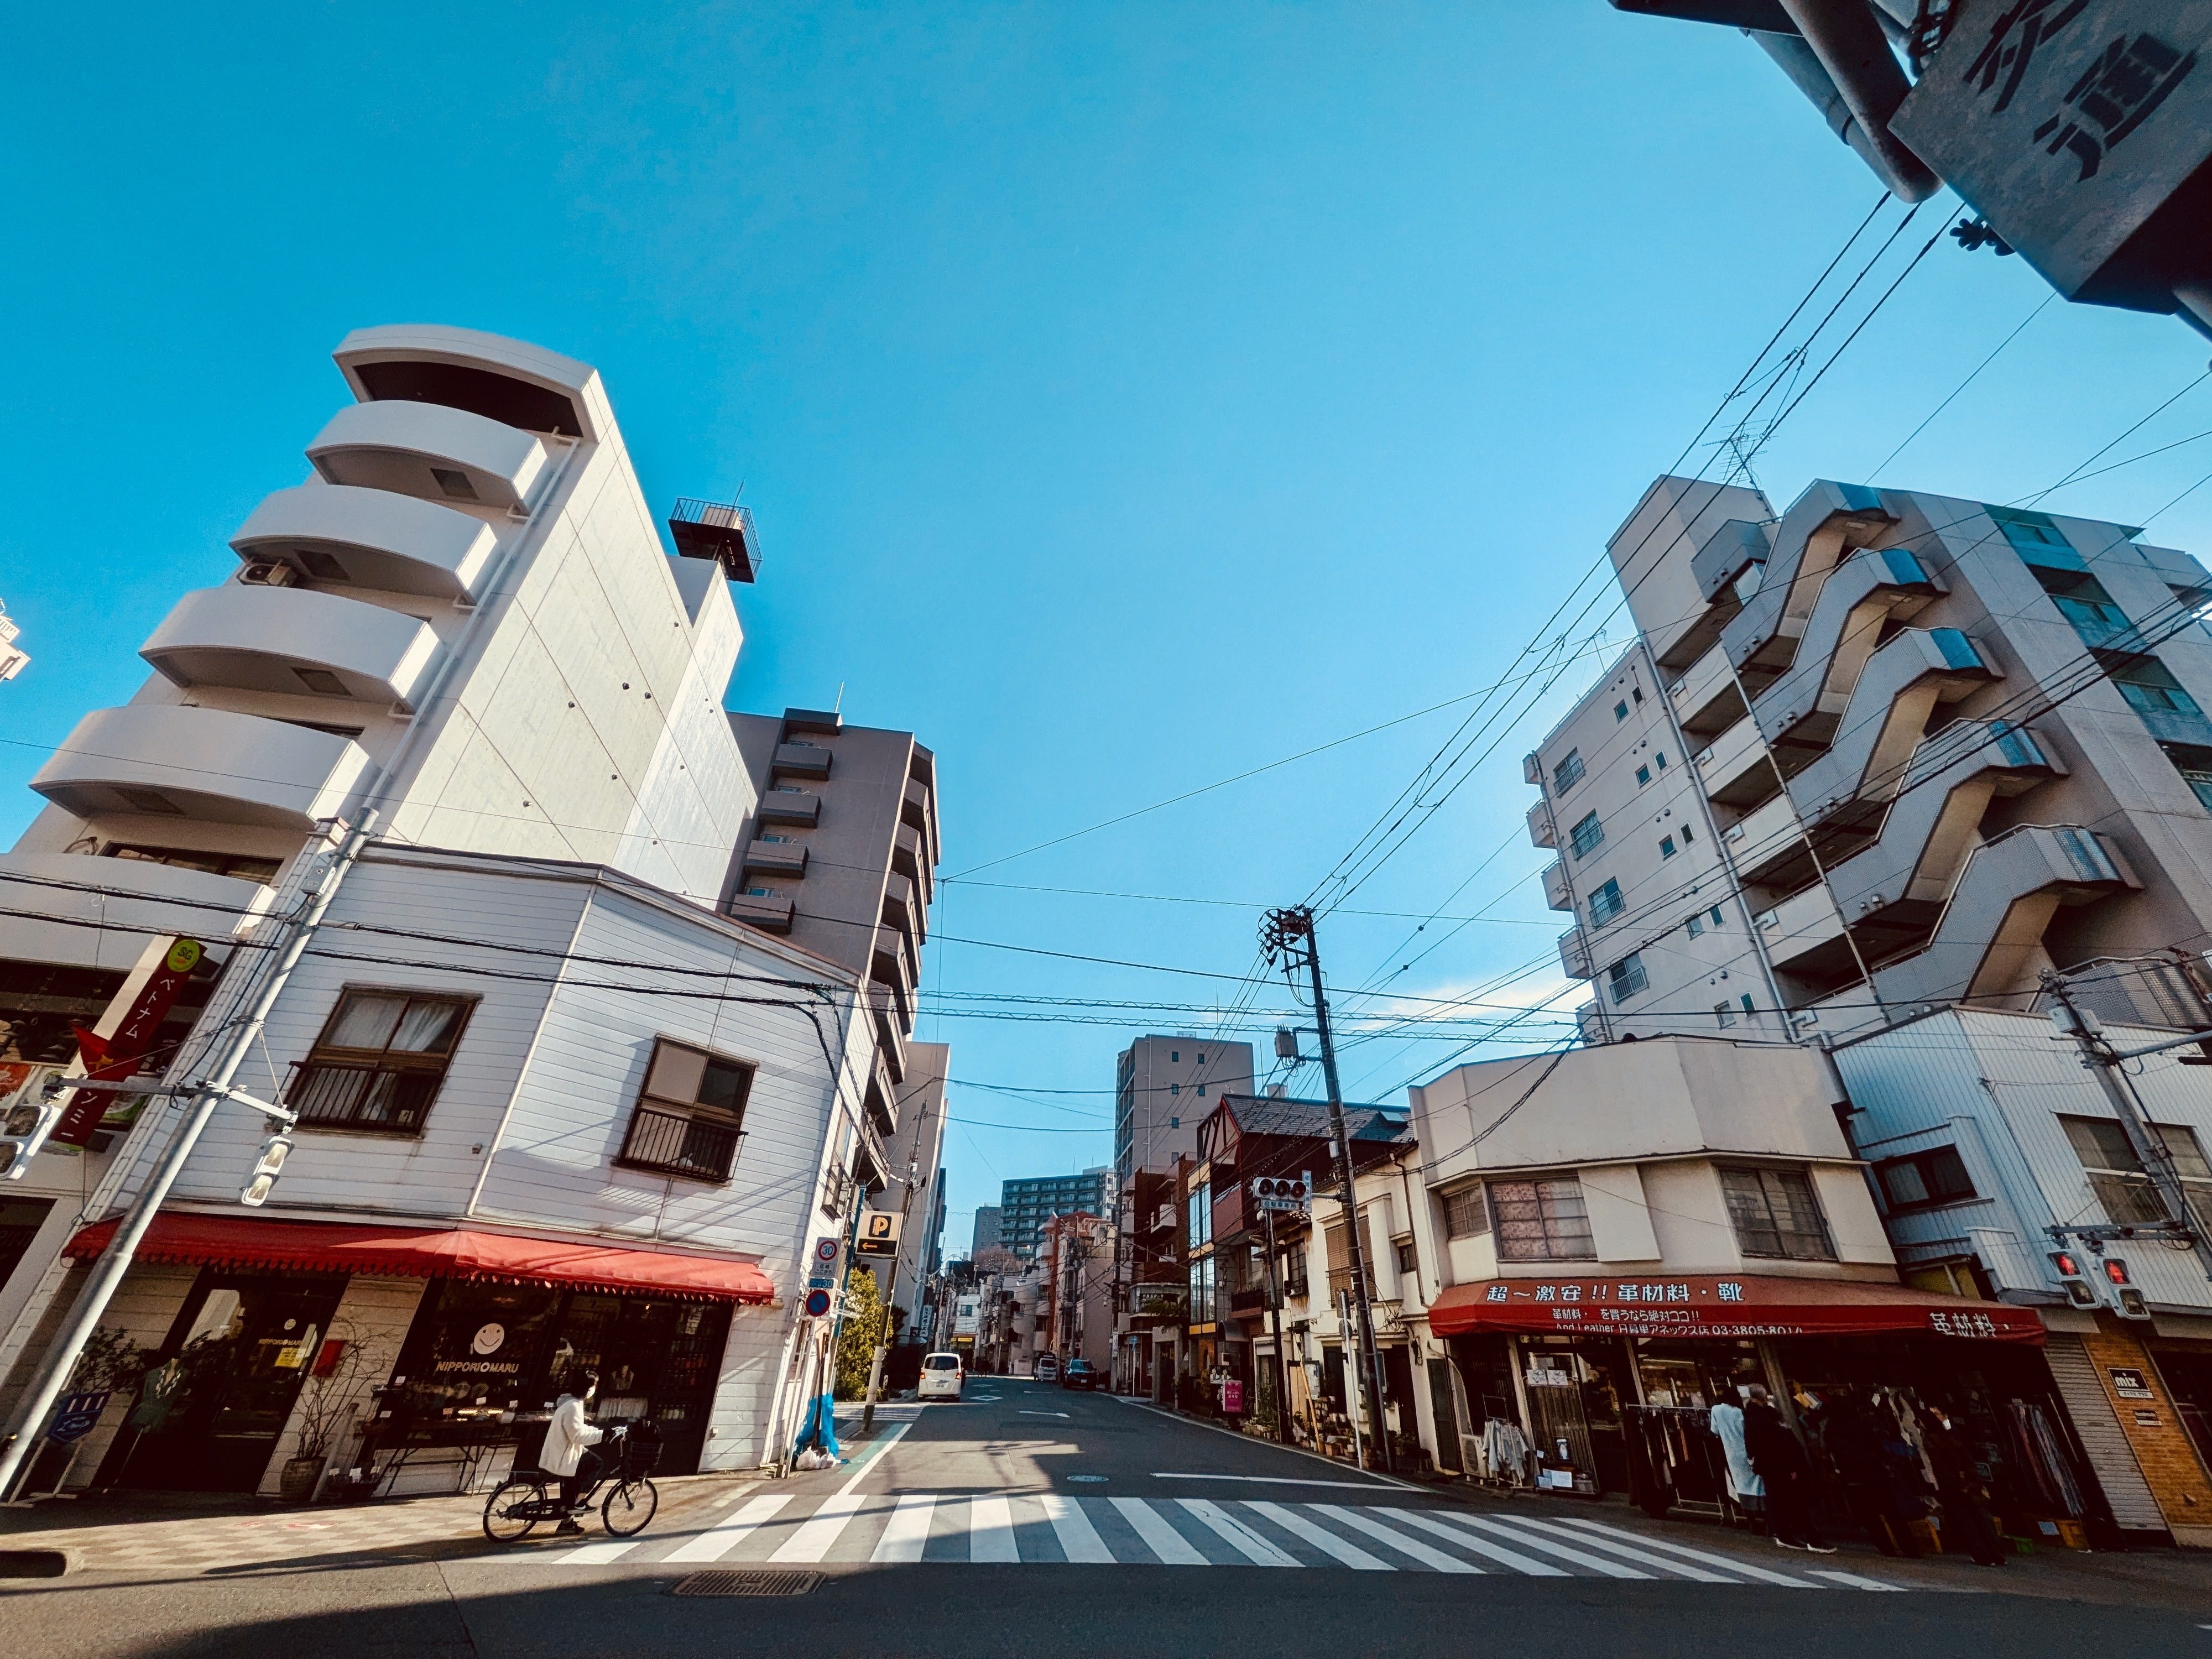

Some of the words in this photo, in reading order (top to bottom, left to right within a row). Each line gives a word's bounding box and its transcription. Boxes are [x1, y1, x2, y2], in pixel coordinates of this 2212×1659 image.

[176, 946, 194, 961] SG
[126, 978, 175, 1039] ベトナム
[822, 1246, 833, 1255] 30
[2115, 1372, 2140, 1387] mix
